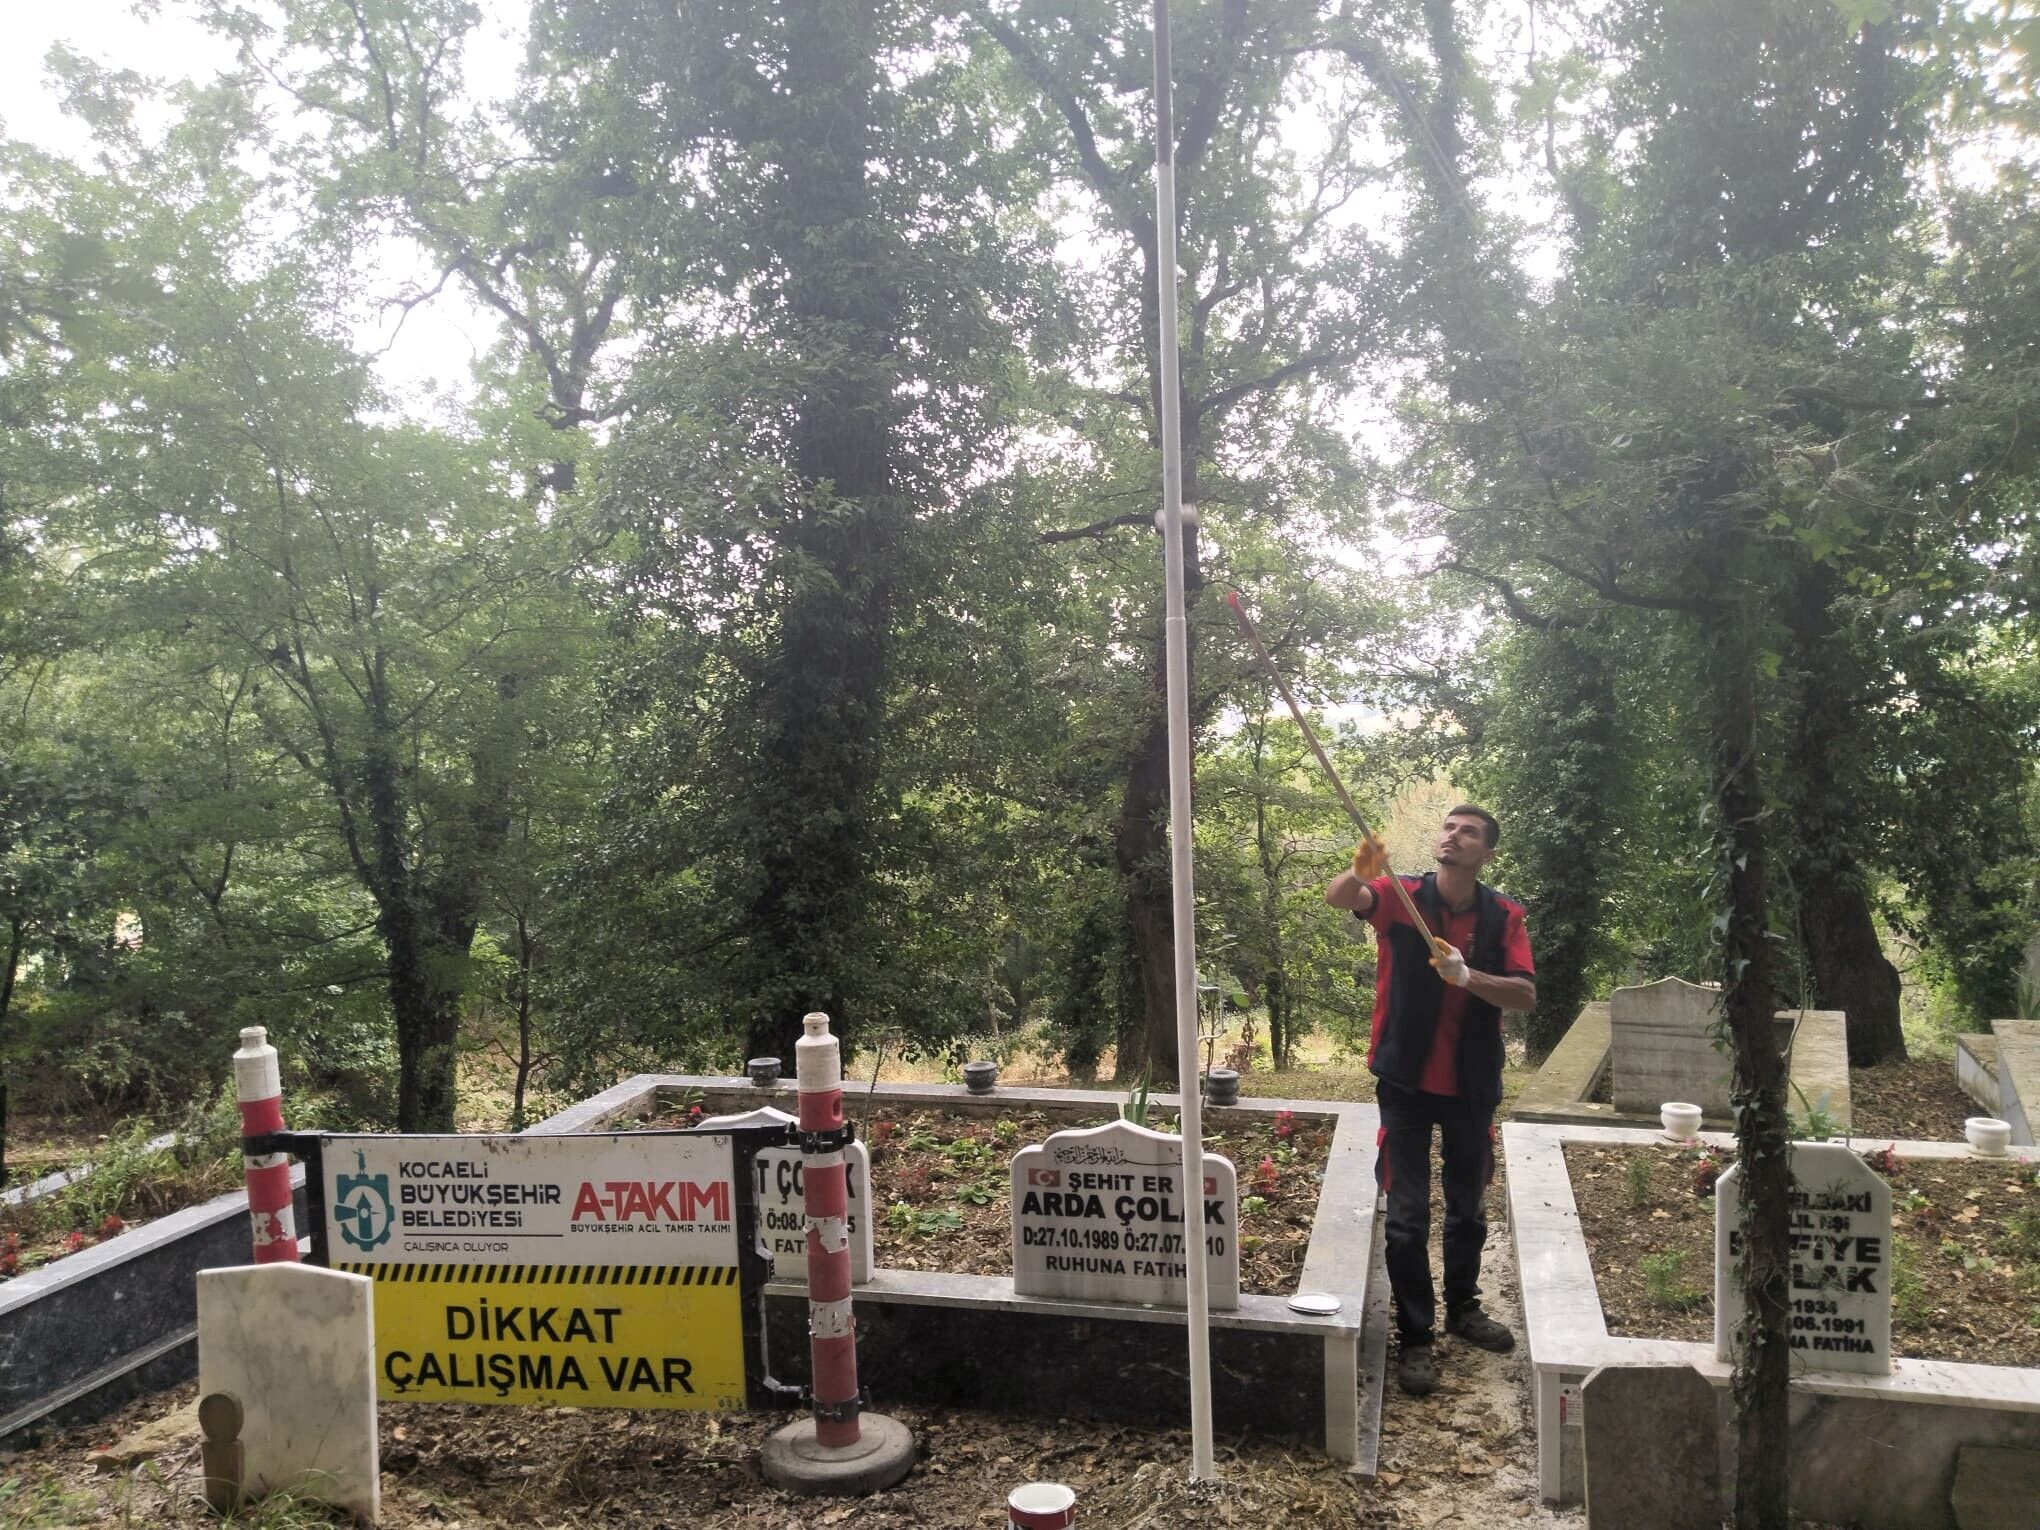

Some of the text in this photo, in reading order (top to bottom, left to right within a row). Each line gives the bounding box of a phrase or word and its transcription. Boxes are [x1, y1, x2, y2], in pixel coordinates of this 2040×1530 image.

[1143, 1176, 1173, 1193] ER
[571, 1182, 730, 1221] A-TAKIMI
[1021, 1192, 1225, 1226] ARDA ÇOLK
[699, 1224, 731, 1233] TAKIMI
[1023, 1226, 1225, 1256] D:27.10.1989 Ö:27.07.10
[404, 1242, 509, 1252] ÇALIŞINCA OLUYOR
[1046, 1255, 1188, 1278] RUHUNA FATİH
[446, 1297, 622, 1343] DİKKAT
[385, 1350, 696, 1397] ÇALIŞMA VAR
